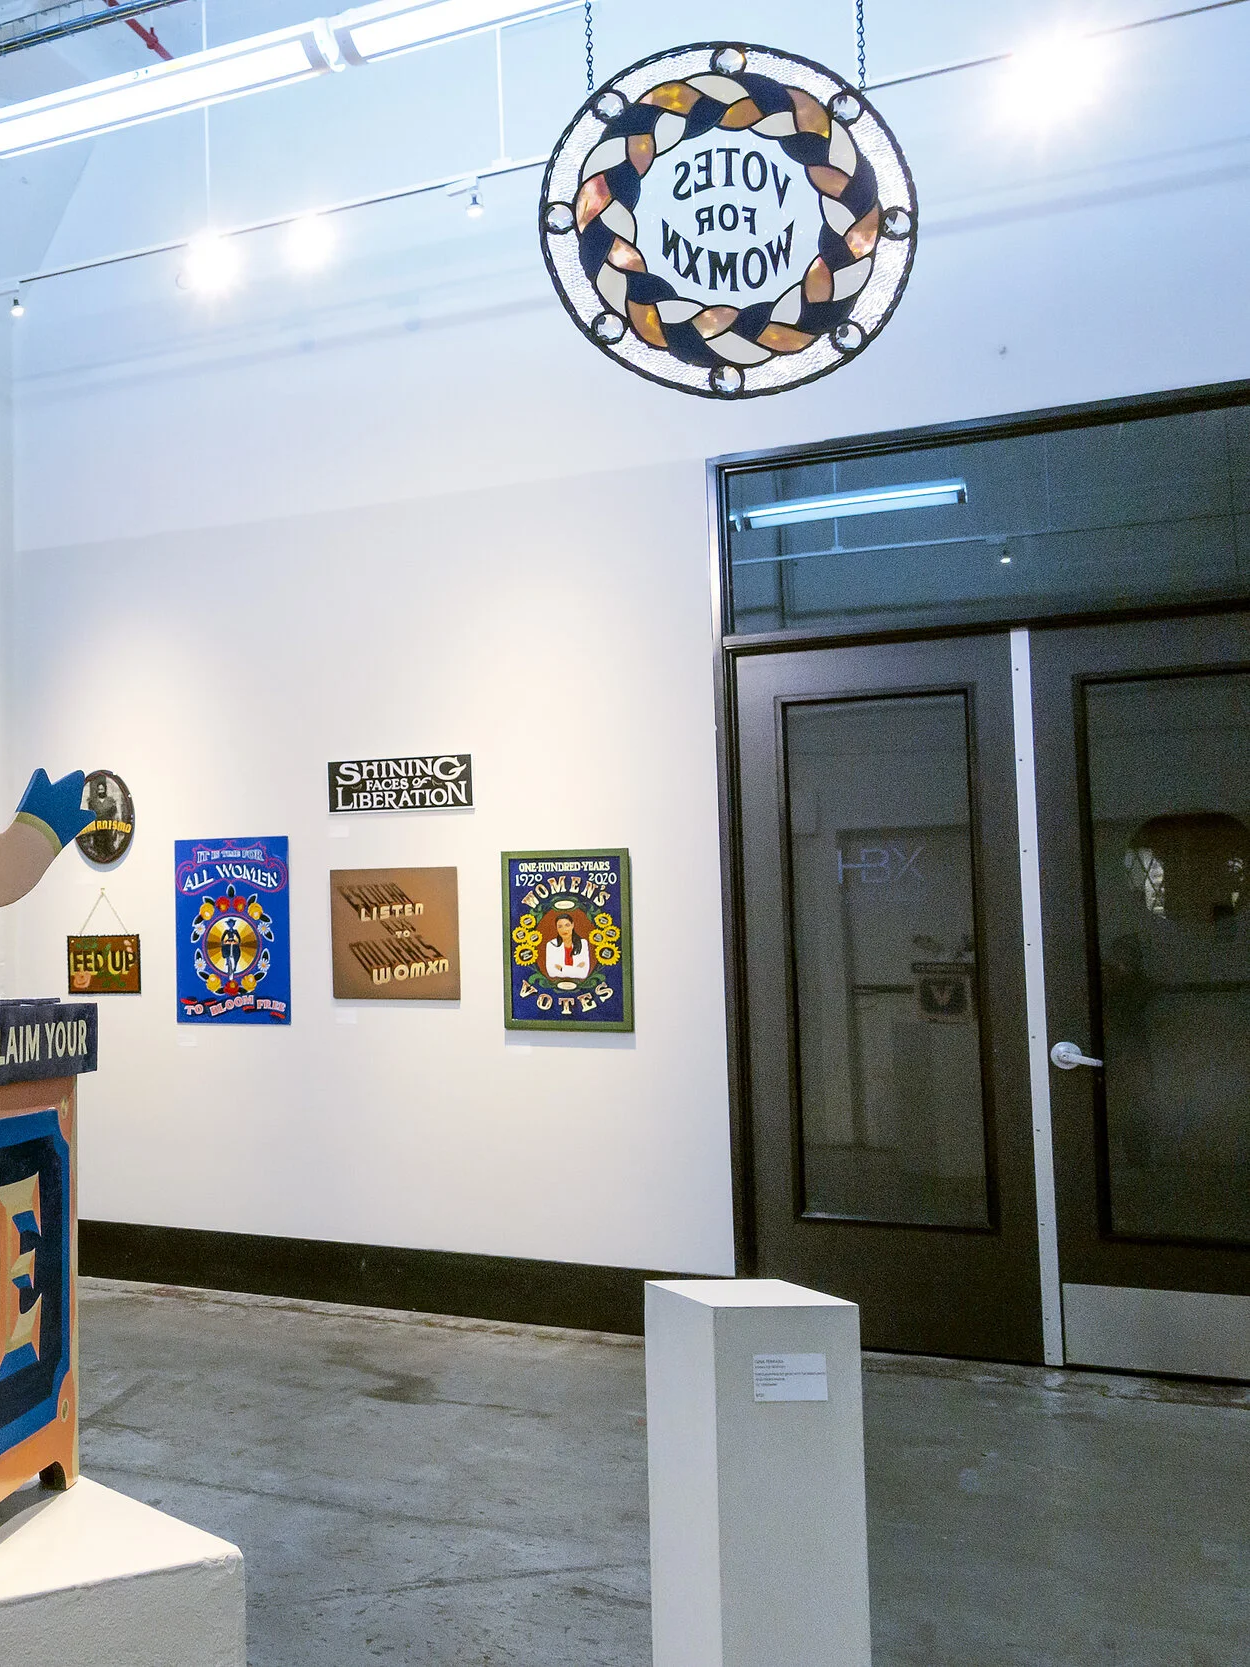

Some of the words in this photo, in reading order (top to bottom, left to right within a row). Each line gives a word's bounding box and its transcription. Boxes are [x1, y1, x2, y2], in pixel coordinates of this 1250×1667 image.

[336, 756, 467, 786] SHINING
[366, 778, 409, 791] FACES
[336, 780, 468, 811] LIBERATION
[242, 849, 265, 862] FOR
[183, 872, 214, 892] ALL
[215, 862, 279, 888] WOMEN
[515, 873, 543, 887] 1920
[588, 872, 617, 885] 2020
[521, 875, 611, 909] WOMEN'S
[395, 930, 411, 939] TO
[107, 950, 136, 976] UP
[184, 1003, 204, 1016] TO
[209, 995, 255, 1017] BLOOM
[256, 998, 286, 1013] FREE
[519, 979, 614, 1015] VOTES
[42, 1018, 89, 1060] YOUR
